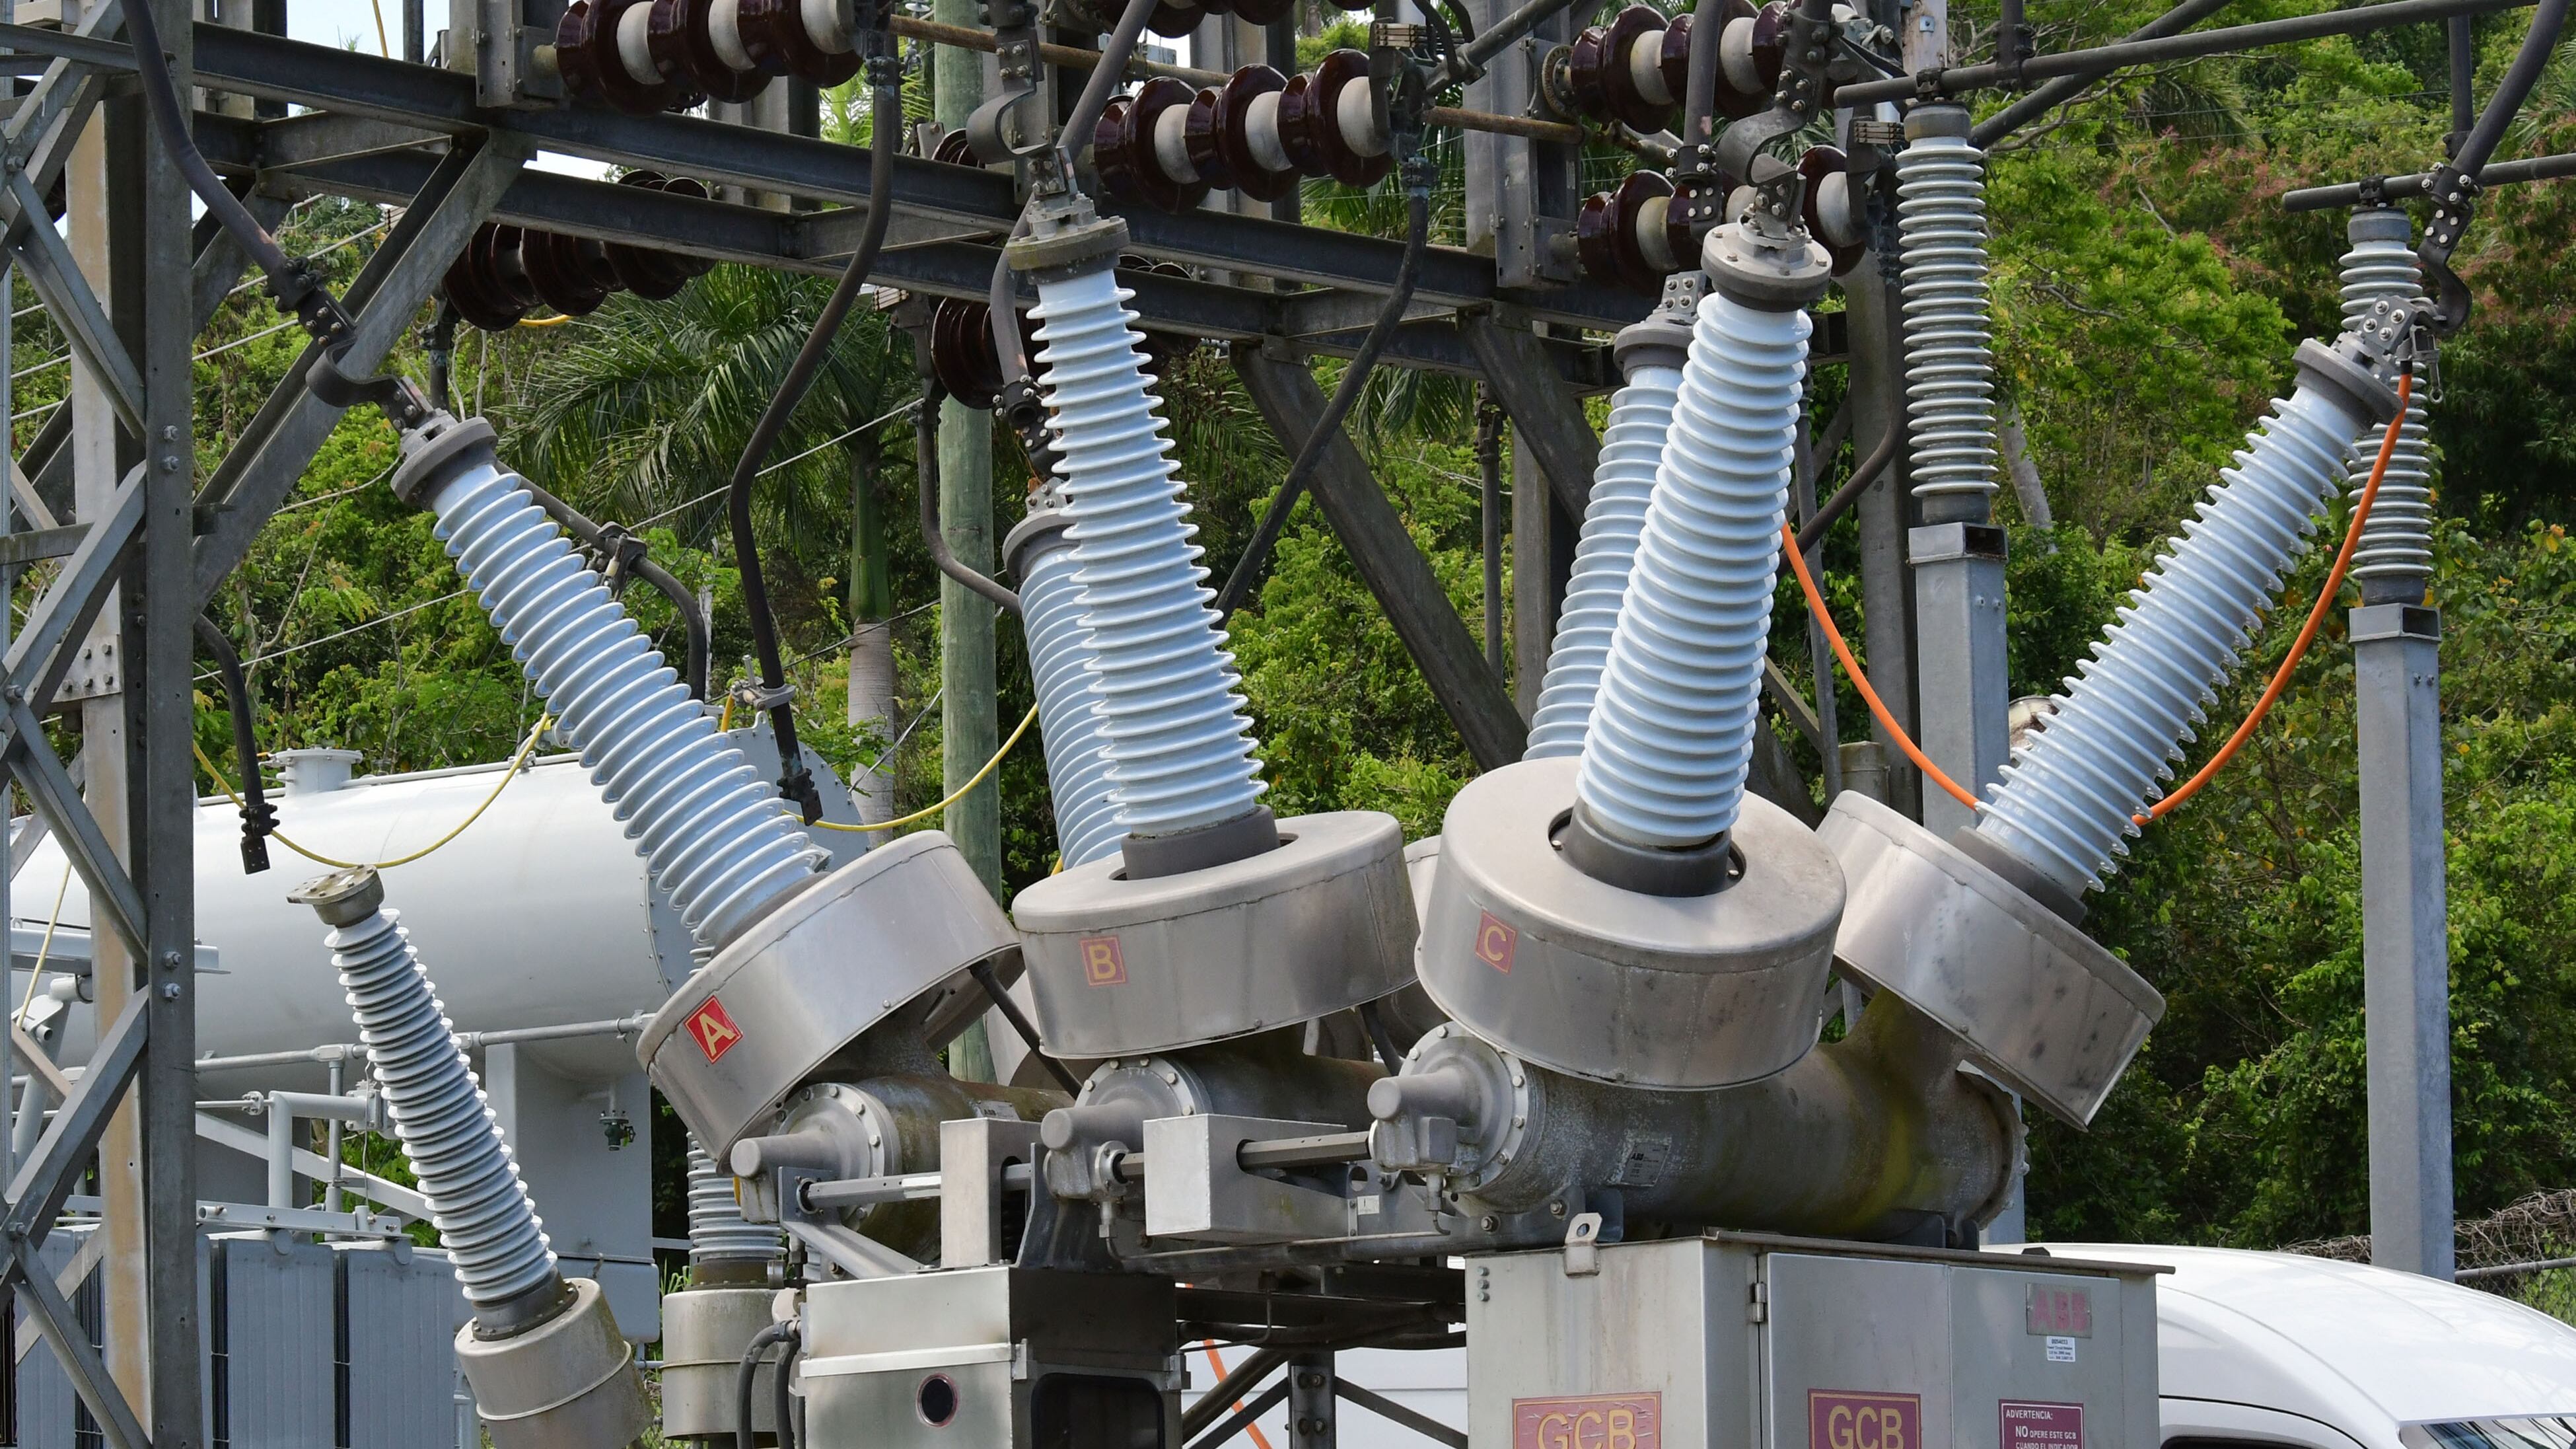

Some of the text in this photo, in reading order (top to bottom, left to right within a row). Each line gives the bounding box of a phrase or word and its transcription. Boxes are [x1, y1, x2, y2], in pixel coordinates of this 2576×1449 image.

[1484, 926, 1507, 961] C
[1089, 945, 1116, 980] B
[699, 1013, 736, 1057] A
[2032, 1290, 2087, 1332] ABB
[1537, 1409, 1637, 1449] GCB
[1828, 1405, 1904, 1449] GCB
[2005, 1409, 2054, 1421] ADVERTENCIA:
[2015, 1425, 2077, 1440] NO OPERE ESTE GCB
